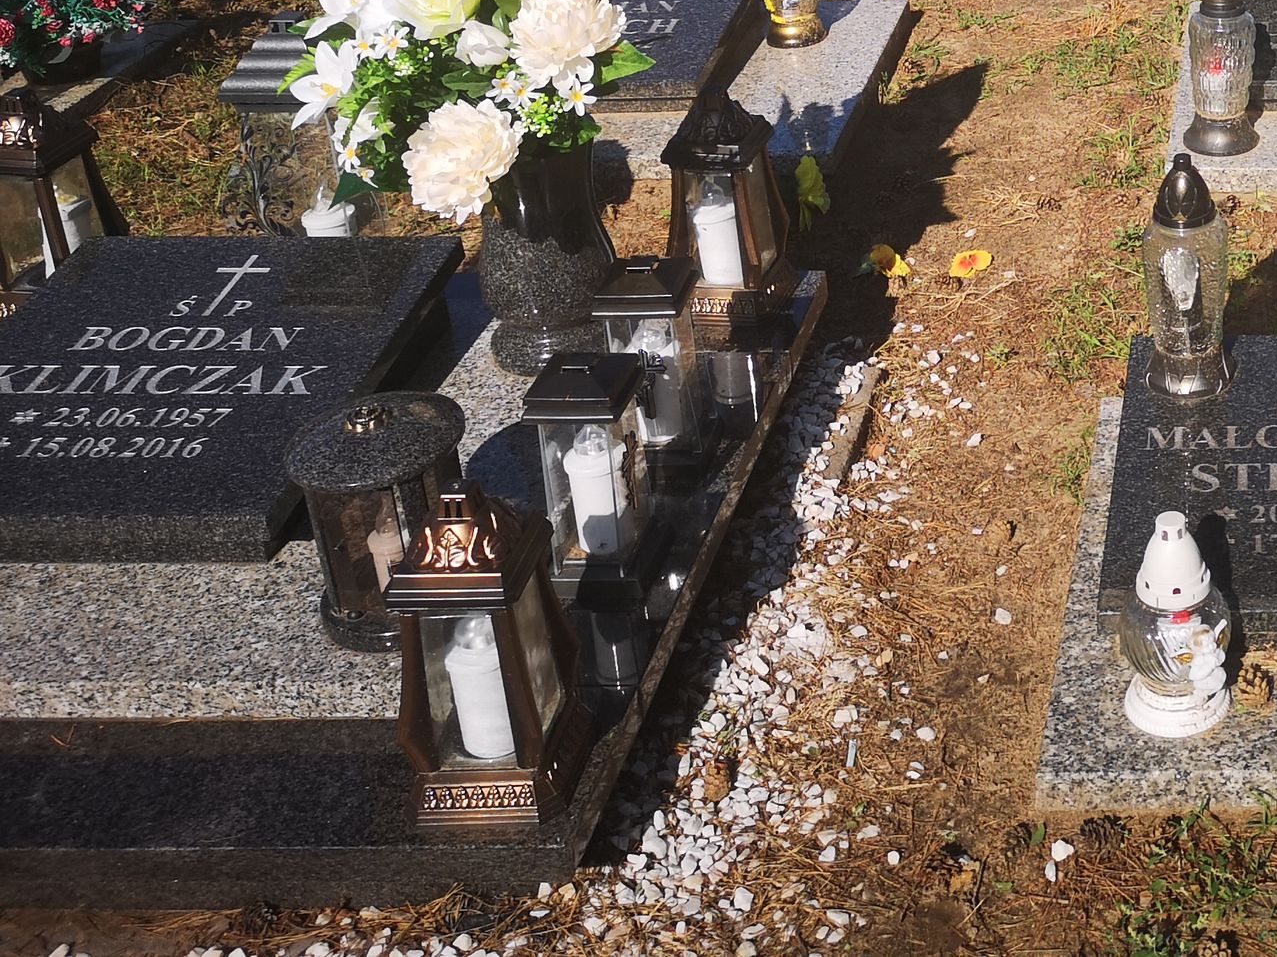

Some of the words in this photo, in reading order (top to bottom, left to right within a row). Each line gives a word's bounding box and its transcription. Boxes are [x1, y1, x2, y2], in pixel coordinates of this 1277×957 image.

[168, 295, 199, 317] Ś
[223, 300, 253, 317] P
[67, 326, 304, 352] BOGDAN
[42, 407, 233, 429] 23.06.1957
[16, 436, 209, 459] 15.08.2016
